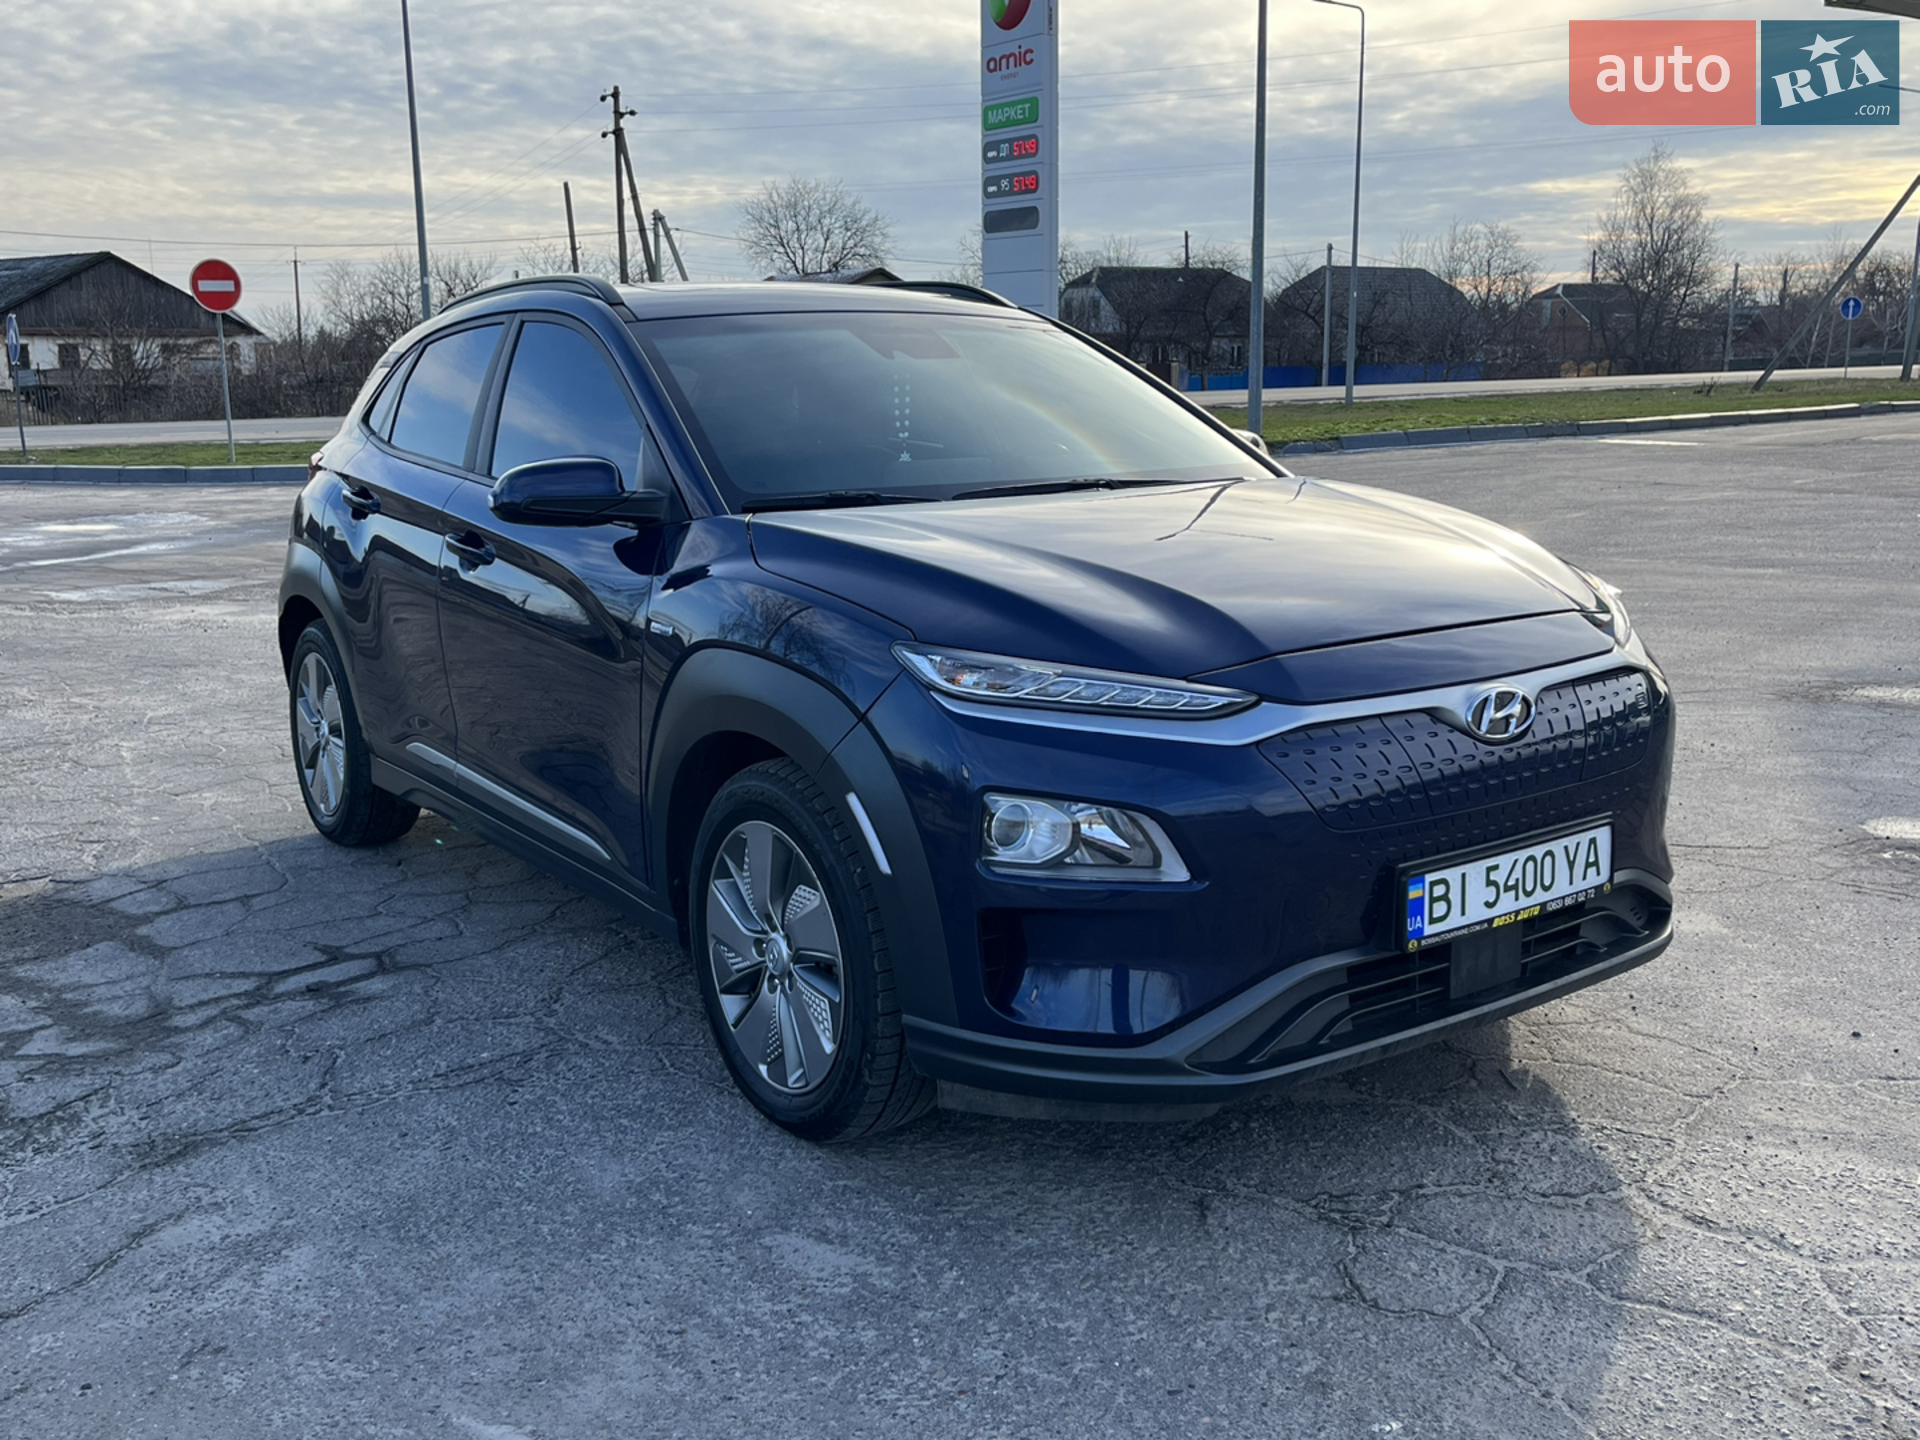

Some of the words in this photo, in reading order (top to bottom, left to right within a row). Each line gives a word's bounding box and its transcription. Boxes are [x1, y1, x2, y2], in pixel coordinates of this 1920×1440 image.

[986, 44, 1034, 74] amic
[988, 103, 1031, 124] МАРКЕТ
[1000, 178, 1010, 192] 95
[1428, 872, 1467, 926] BI
[1483, 848, 1556, 909] 5400
[1563, 836, 1602, 886] YA
[1407, 915, 1422, 931] UA
[1492, 912, 1516, 928] BOSS
[1516, 905, 1541, 922] AUTO
